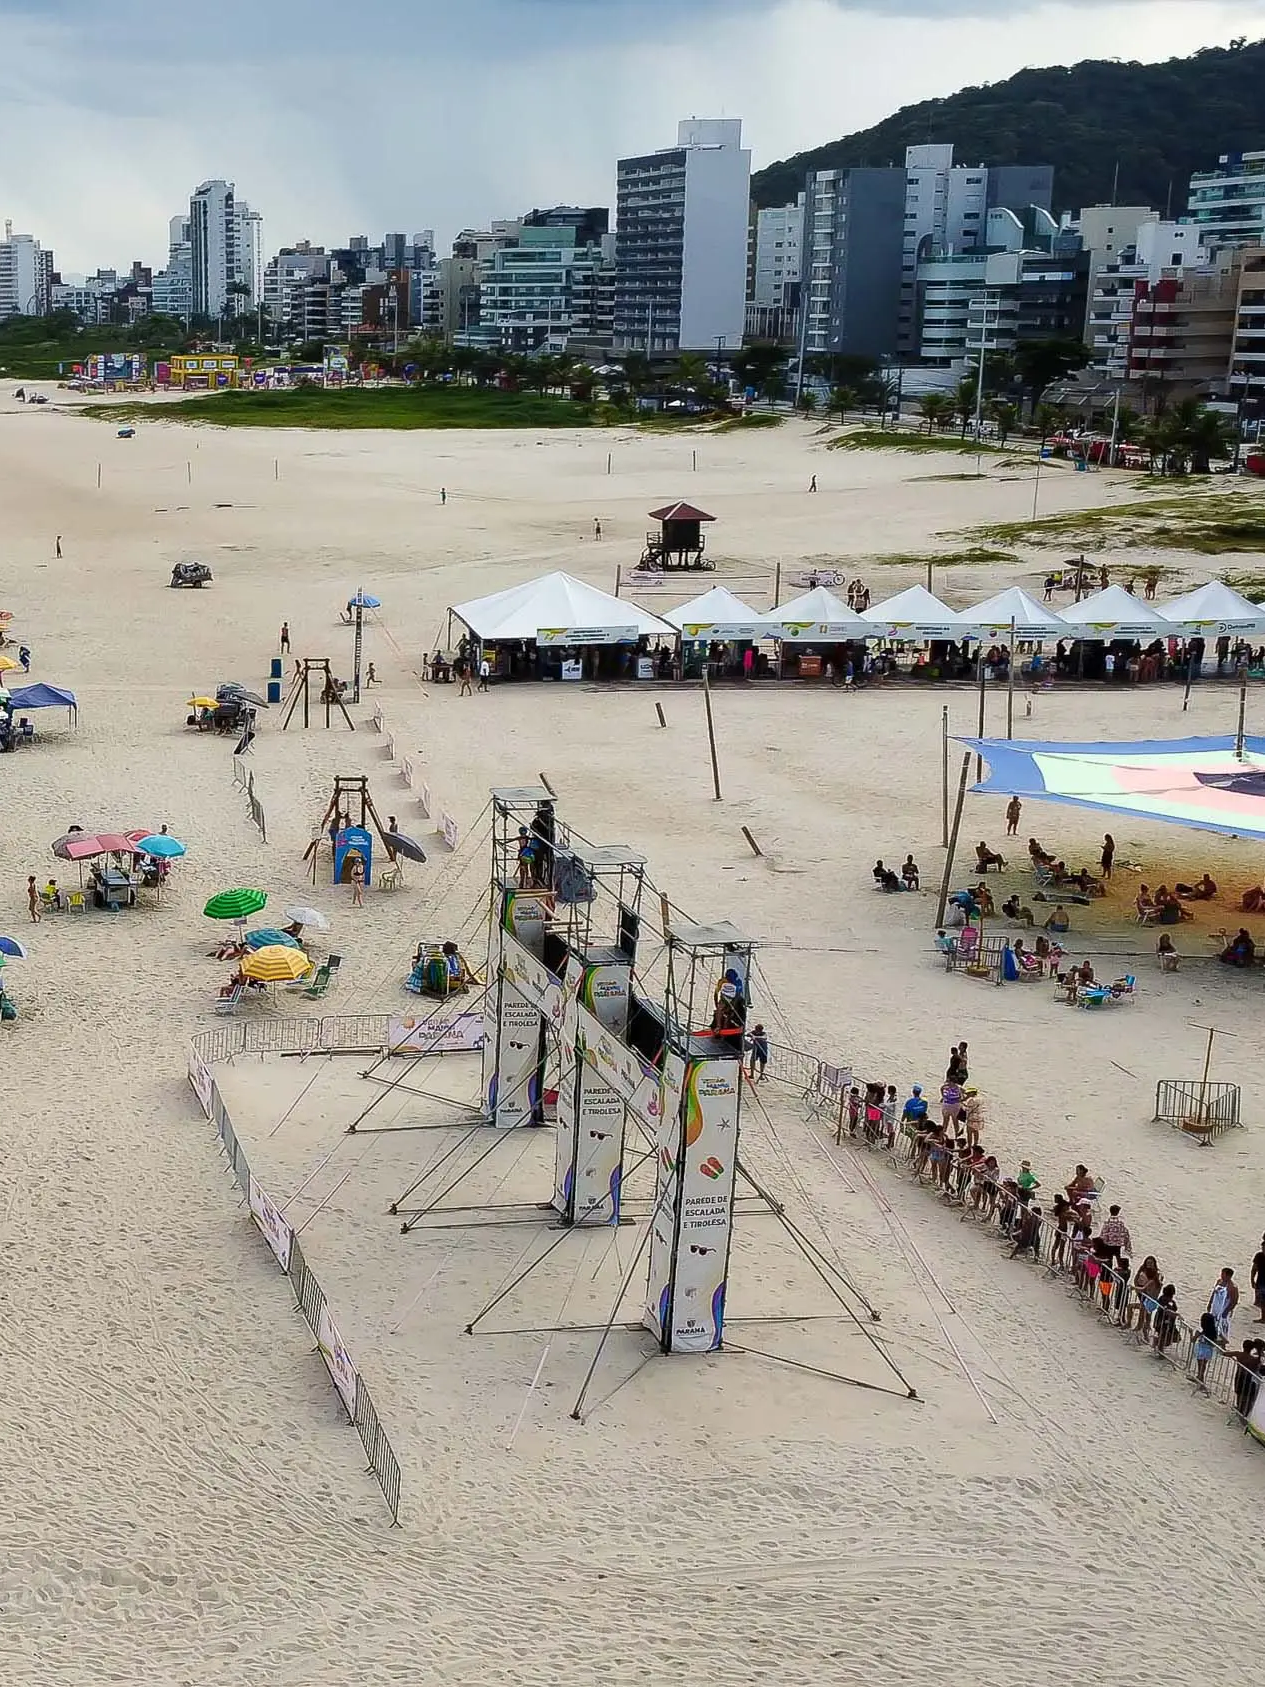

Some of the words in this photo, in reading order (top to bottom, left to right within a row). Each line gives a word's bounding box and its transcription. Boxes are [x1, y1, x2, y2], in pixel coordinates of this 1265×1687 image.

[686, 1196, 716, 1206] PAREDE
[686, 1207, 726, 1216] ESCALADA
[690, 1218, 727, 1228] TIROLESA
